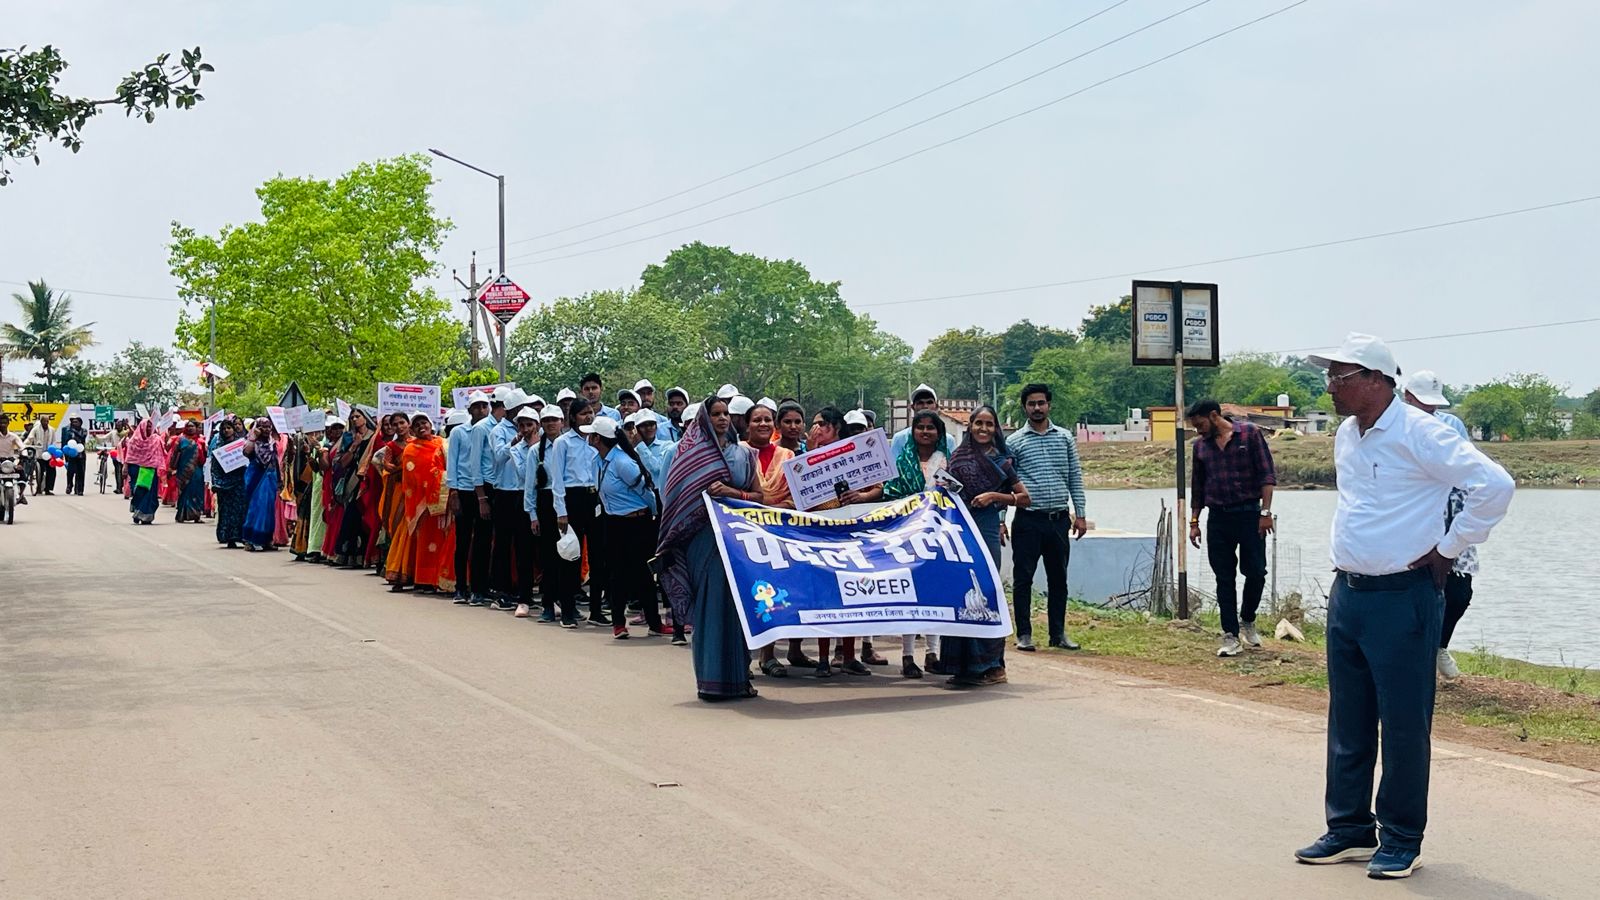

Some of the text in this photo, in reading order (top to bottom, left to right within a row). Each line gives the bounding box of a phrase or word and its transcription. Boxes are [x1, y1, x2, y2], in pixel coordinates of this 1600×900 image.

[832, 456, 848, 470] कभी
[847, 456, 854, 464] न
[855, 450, 873, 462] आना
[800, 485, 814, 497] सोच
[727, 510, 975, 570] पैदल रैली
[844, 577, 911, 597] SWEEP
